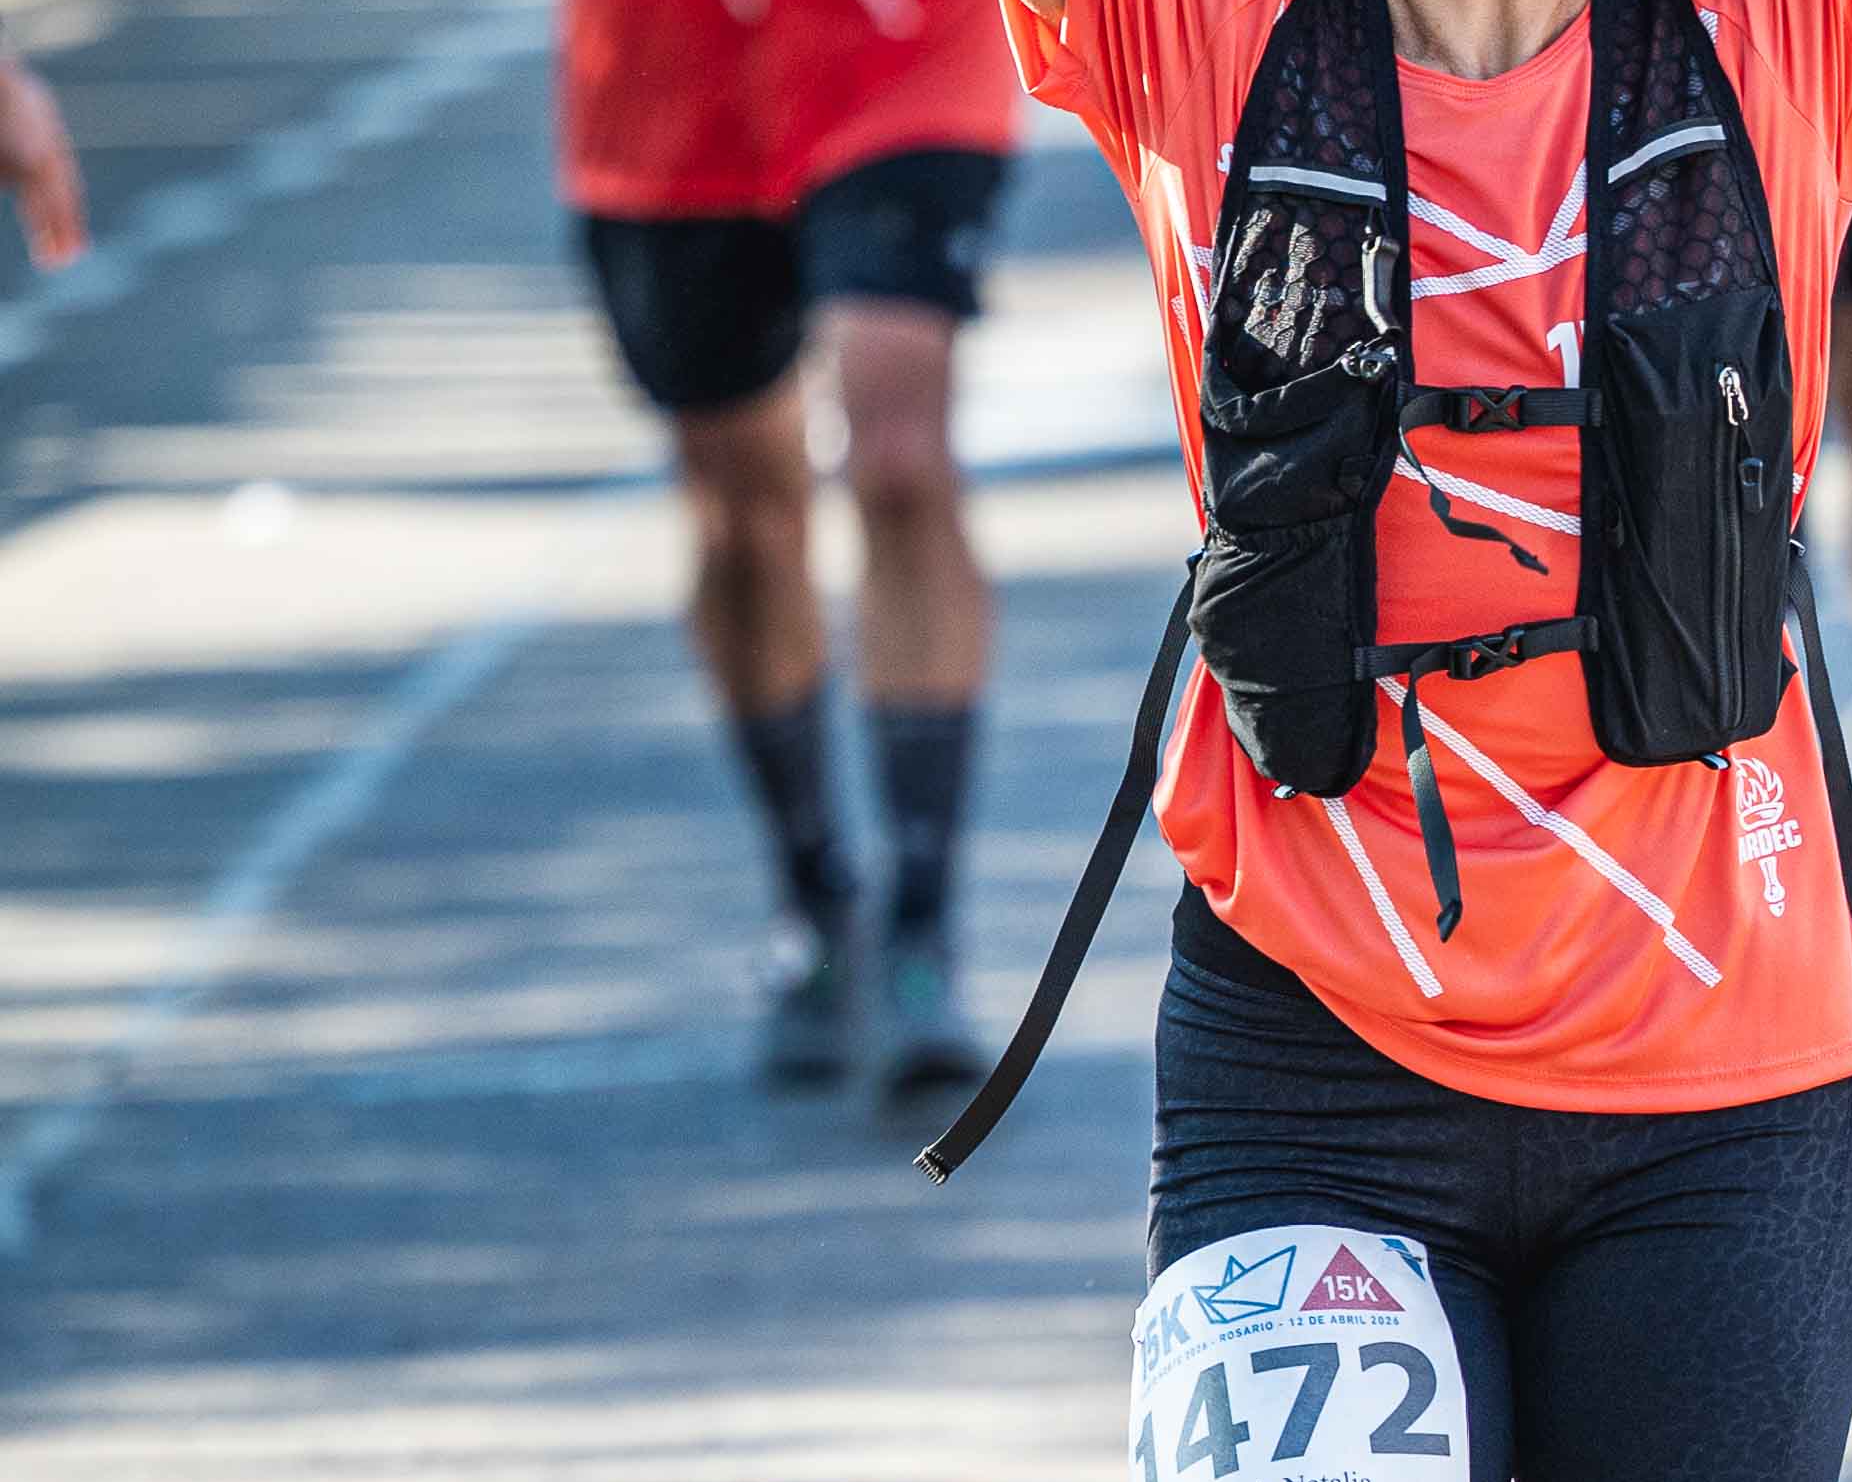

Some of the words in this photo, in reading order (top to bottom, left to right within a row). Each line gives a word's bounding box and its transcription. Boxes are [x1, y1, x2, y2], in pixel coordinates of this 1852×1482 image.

[1322, 1275, 1379, 1303] 15K
[1218, 1320, 1274, 1343] ROSARIO
[1290, 1317, 1303, 1327] 12
[1309, 1315, 1325, 1325] DE
[1330, 1315, 1366, 1325] ABRIL
[1371, 1316, 1400, 1326] 2026
